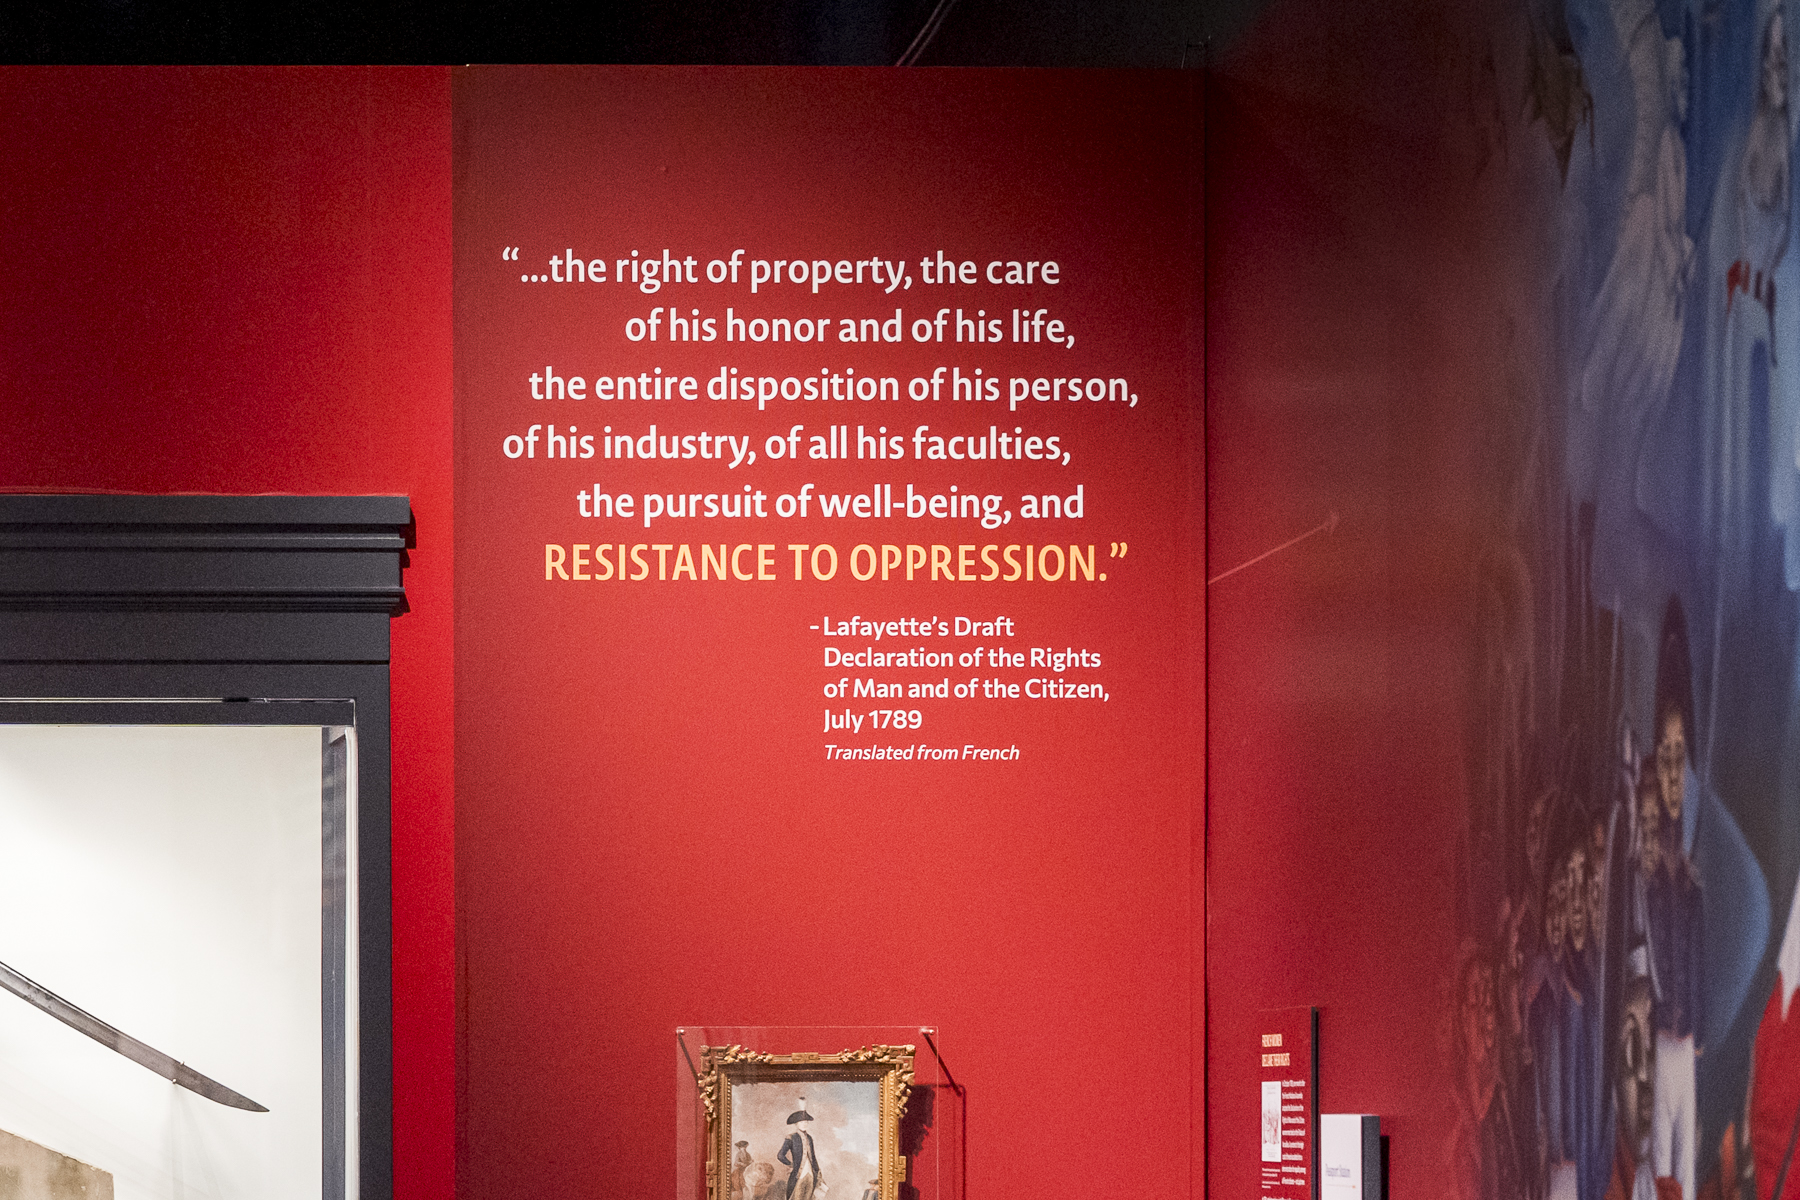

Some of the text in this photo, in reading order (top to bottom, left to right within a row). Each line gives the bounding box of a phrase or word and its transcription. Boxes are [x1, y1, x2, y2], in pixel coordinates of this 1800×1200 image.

[616, 248, 699, 294] right
[706, 248, 745, 284] of
[750, 256, 913, 294] property,
[919, 250, 977, 285] the
[986, 260, 1060, 285] care
[625, 306, 1075, 349] of his honor and of his life,
[528, 365, 1138, 412] the entire disposition of his person,
[502, 424, 1071, 470] of his industry, of all his faculties,
[576, 483, 1084, 530] the pursuit of well-being, and
[545, 542, 1128, 582] RESISTANCE TO OPPRESSION.”
[954, 615, 1015, 637] Draft
[824, 646, 1102, 673] Declaration of the Rights
[823, 677, 1110, 702] of Man and of the Citizen,
[823, 708, 923, 734] July 1789
[824, 744, 1020, 761] Translated from French
